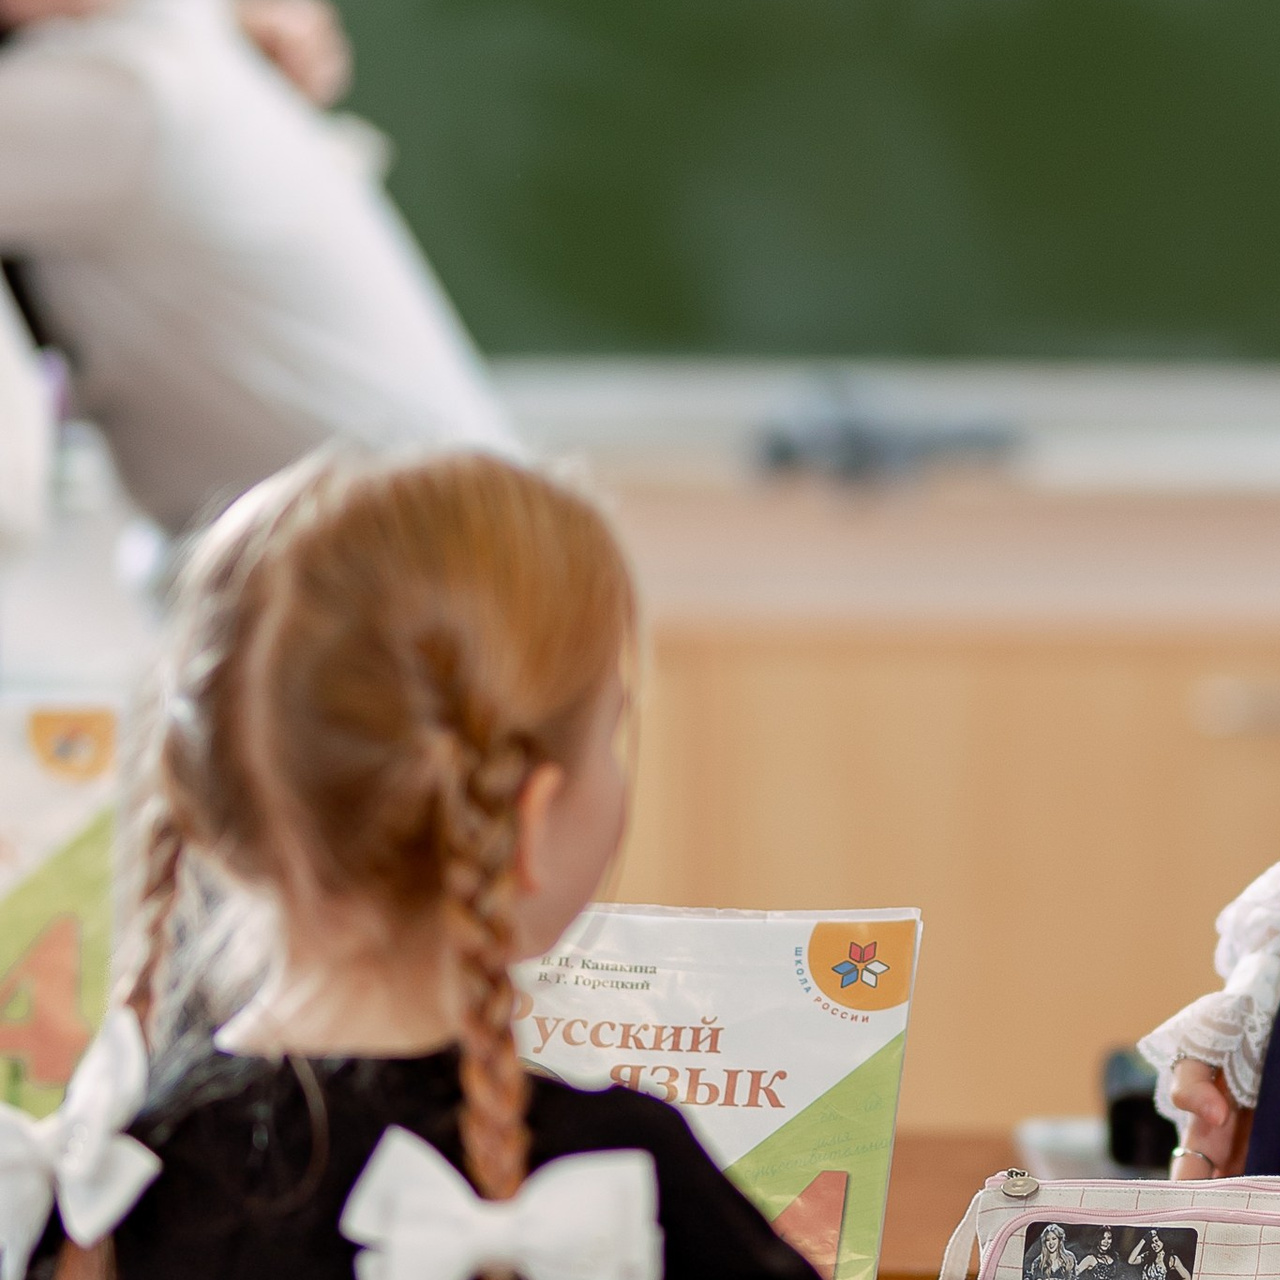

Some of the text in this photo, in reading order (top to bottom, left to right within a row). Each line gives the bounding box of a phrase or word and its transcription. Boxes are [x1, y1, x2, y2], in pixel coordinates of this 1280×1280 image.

[581, 958, 657, 975] Канакина
[574, 974, 651, 991] Горецкий
[794, 946, 870, 1023] ШКОЛА РОССИИ
